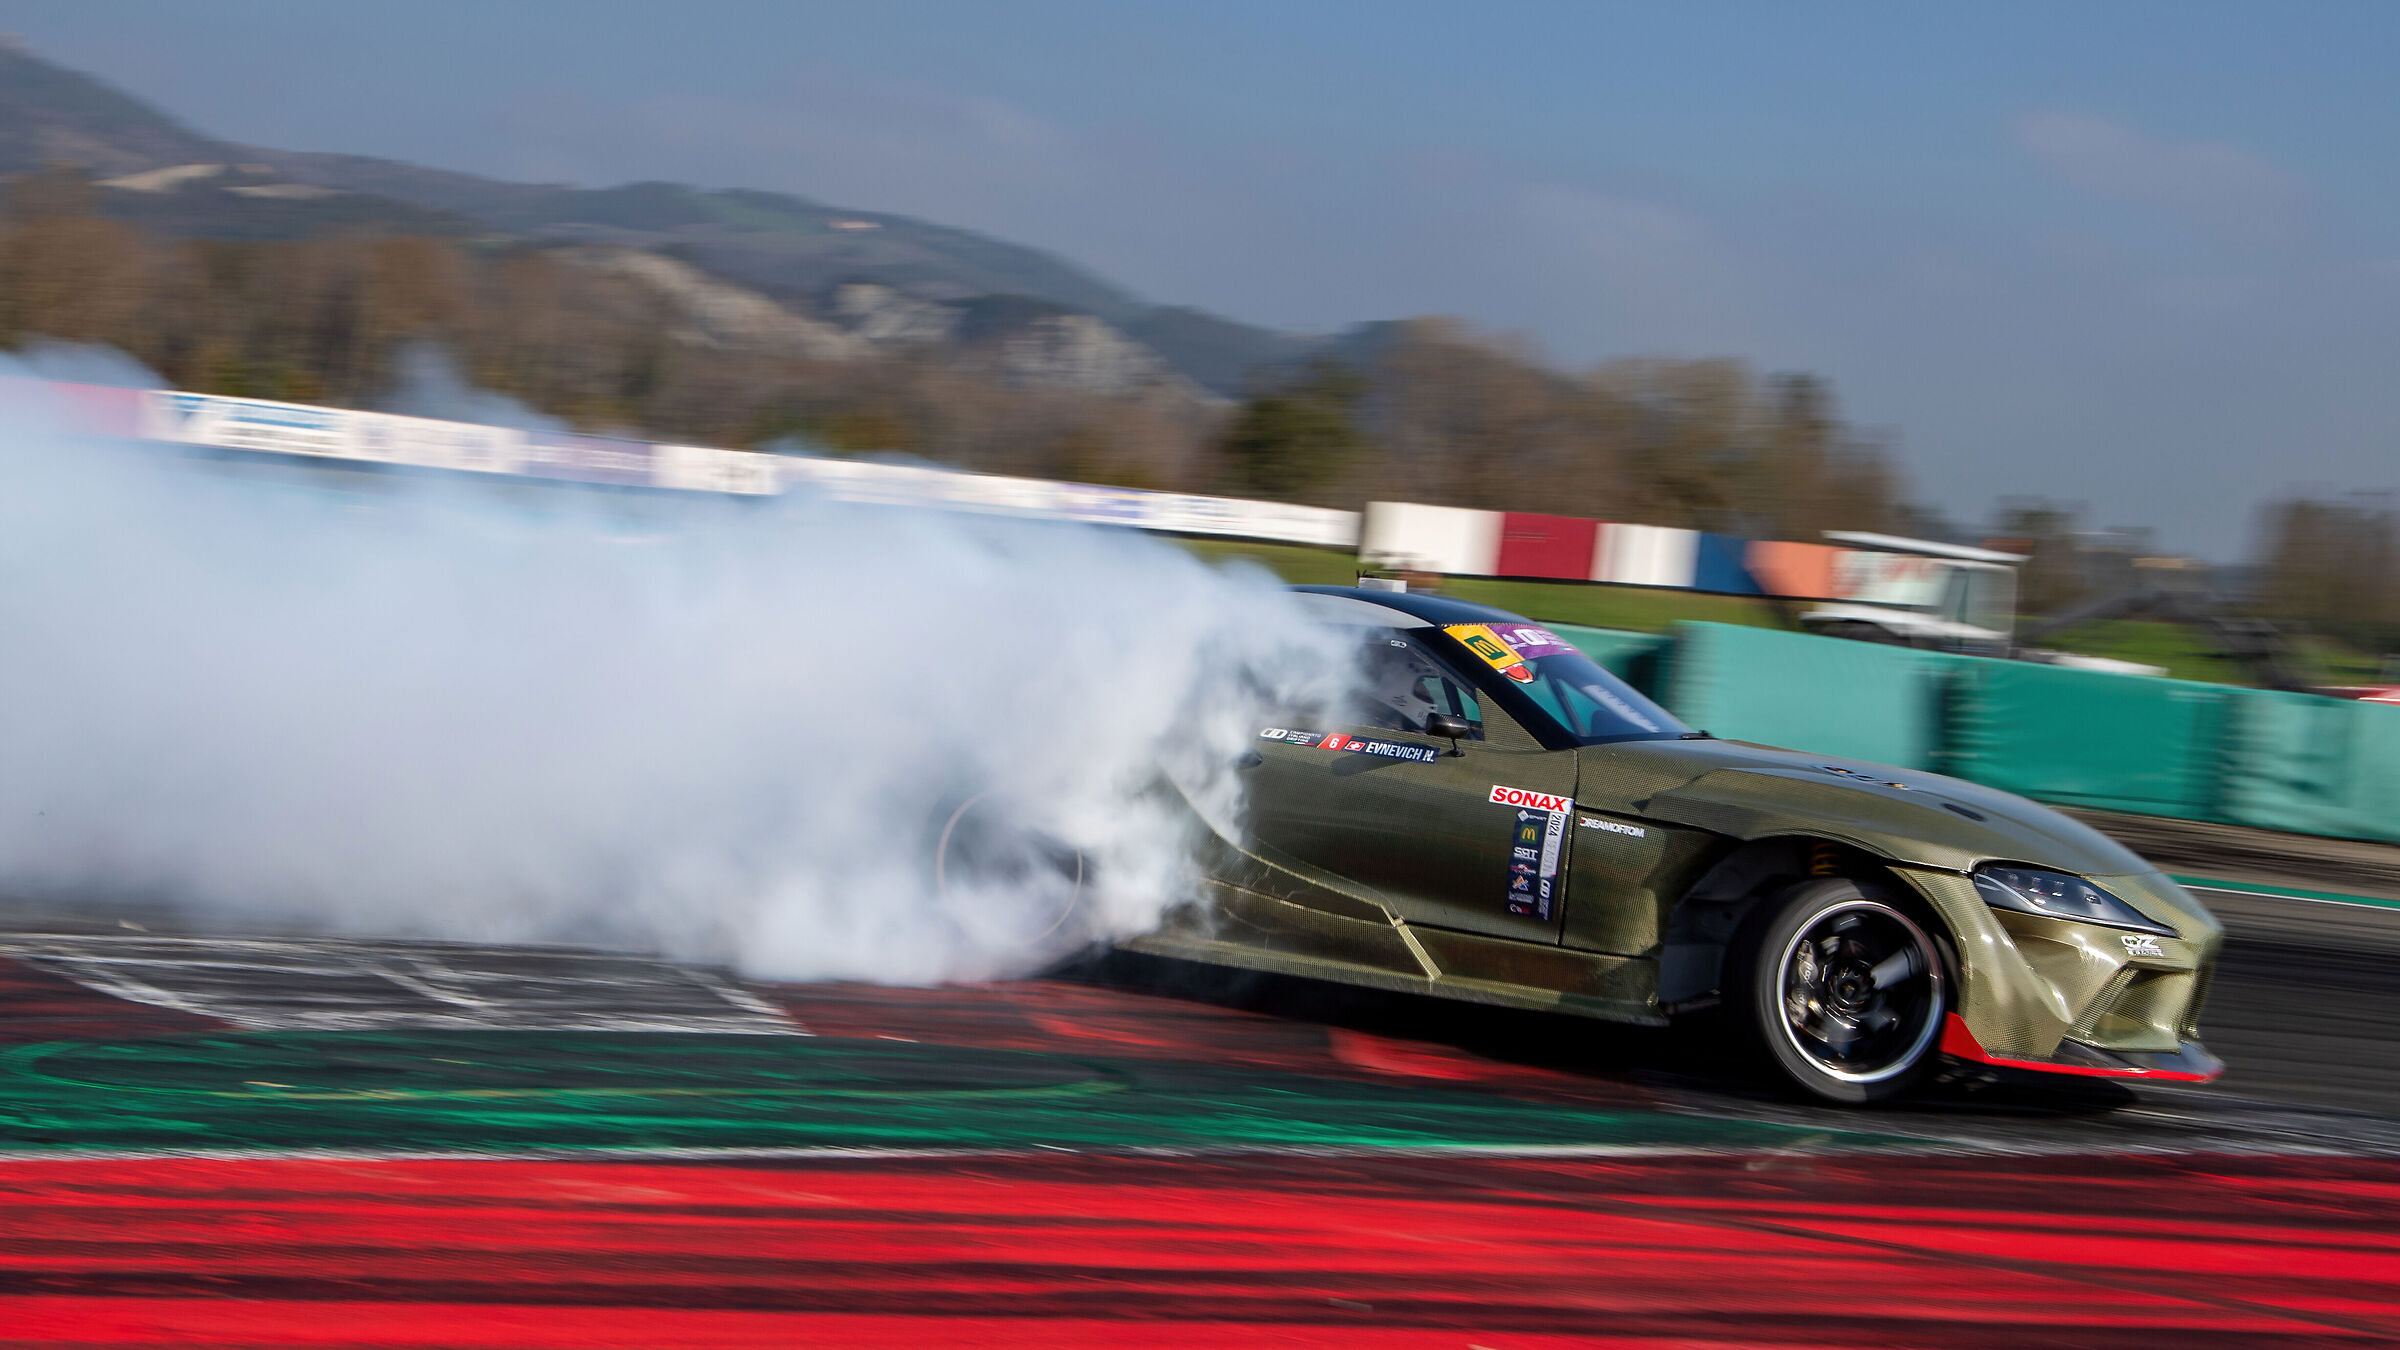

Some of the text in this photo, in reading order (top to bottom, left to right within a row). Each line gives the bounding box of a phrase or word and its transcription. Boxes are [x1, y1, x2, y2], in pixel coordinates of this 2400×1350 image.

[1329, 738, 1340, 749] 6
[1365, 741, 1424, 760] EVNEVICH
[1492, 788, 1567, 812] SONAX
[1547, 814, 1563, 837] 2024
